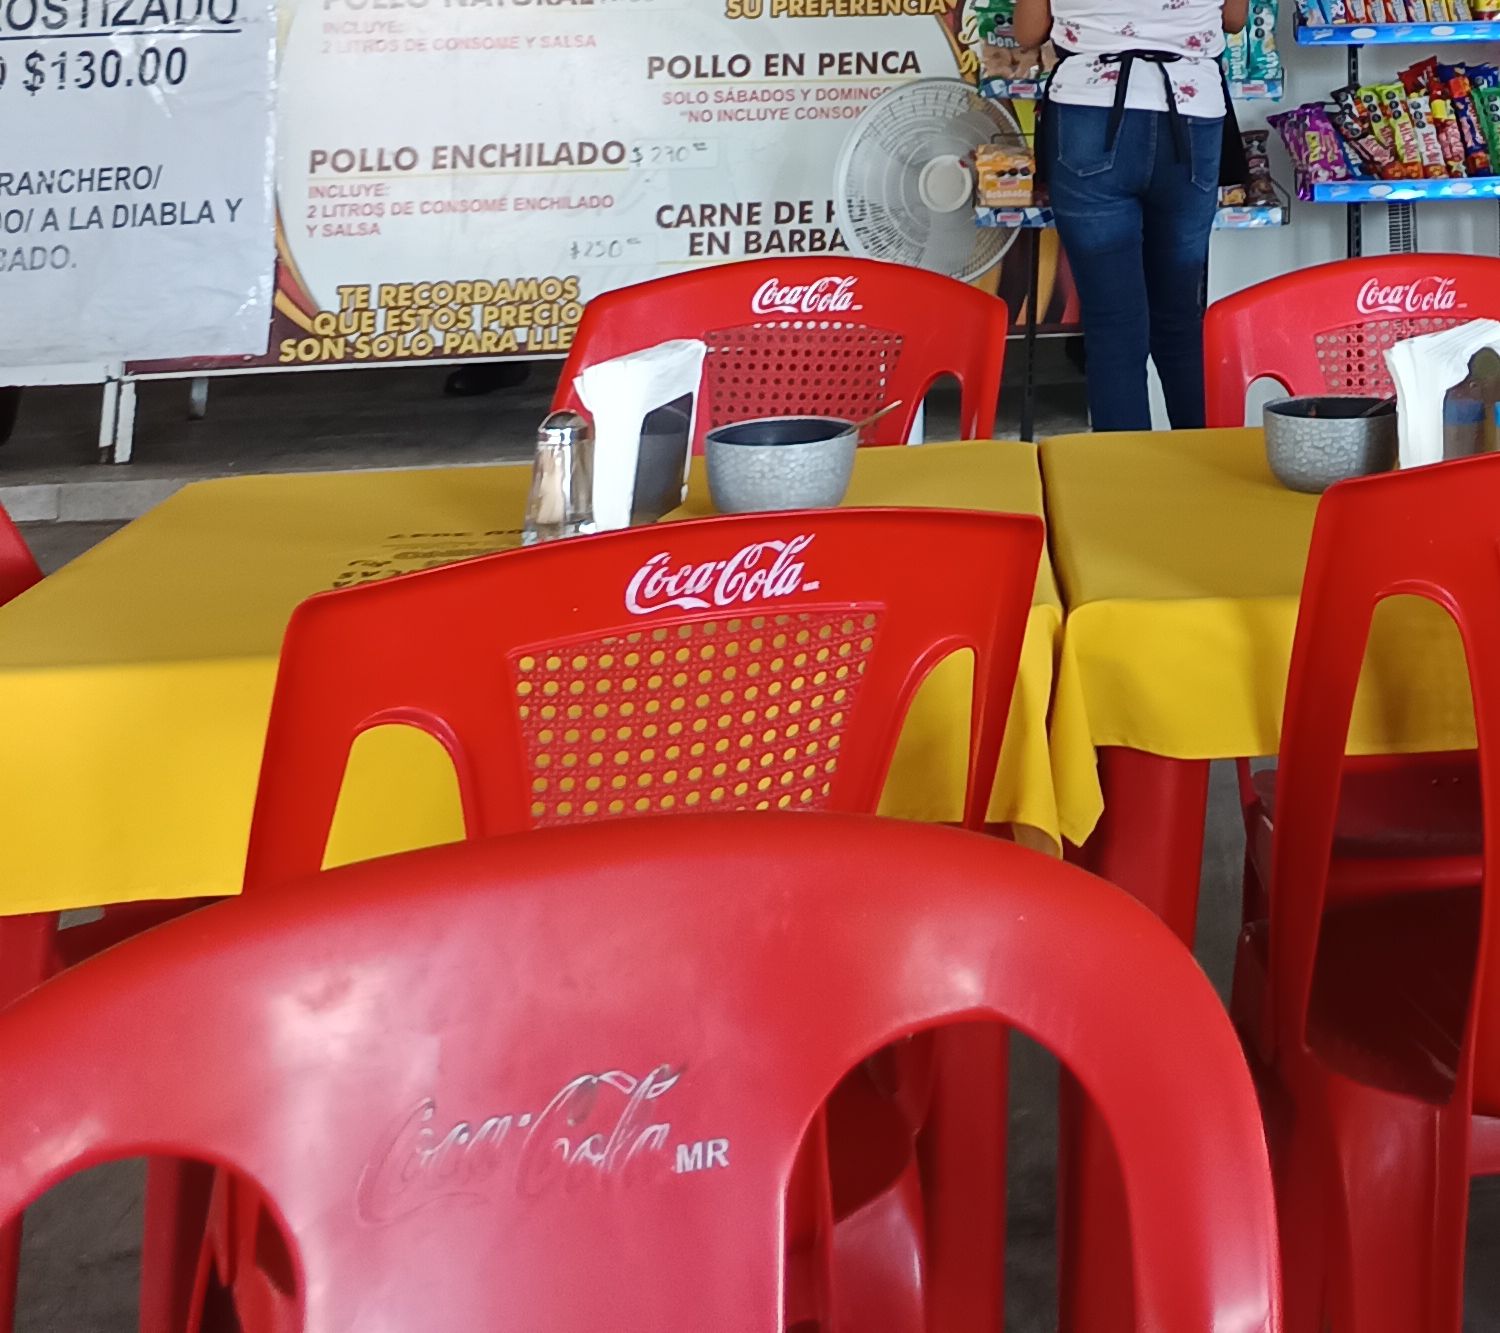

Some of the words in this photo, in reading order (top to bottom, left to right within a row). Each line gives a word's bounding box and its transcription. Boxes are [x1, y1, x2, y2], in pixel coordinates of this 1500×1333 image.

[22, 46, 188, 97] $130.00
[646, 54, 752, 80] POLLO
[763, 52, 806, 77] EN
[817, 50, 922, 76] PENCA
[662, 91, 709, 106] SOLO
[713, 87, 796, 104] SÁBADOS
[800, 88, 812, 101] Y
[717, 107, 791, 122] INCLUYE
[794, 105, 869, 120] CONSOM
[309, 145, 420, 175] POLLO
[432, 140, 627, 170] ENCHILADO
[306, 205, 317, 220] 2
[321, 202, 386, 219] LITROS
[390, 201, 414, 216] DE
[419, 197, 508, 215] CONSOME
[513, 194, 615, 213] ENCHILADO
[308, 182, 390, 200] INCLUYE:
[40, 207, 60, 233] A
[69, 205, 104, 231] LA
[112, 199, 216, 229] DIABLA
[225, 197, 244, 223] Y
[306, 223, 318, 238] Y
[321, 221, 381, 238] SALSA
[655, 201, 763, 229] CARNE
[774, 200, 814, 224] DE
[688, 231, 731, 257] EN
[744, 229, 850, 255] BARBA
[337, 284, 372, 310] TE
[378, 275, 581, 309] RECORDAMOS
[751, 275, 859, 315] Coca-Cola
[1356, 275, 1457, 315] Coca-Cola
[313, 310, 377, 336] QUE
[386, 306, 474, 332] ESTOS
[482, 302, 584, 328] PRECIO
[278, 337, 345, 364] SON
[353, 332, 434, 360] SOLO
[442, 329, 519, 356] PARA
[526, 326, 577, 351] LLE
[625, 533, 816, 615] Coca-Cola
[675, 1137, 730, 1174] MR
